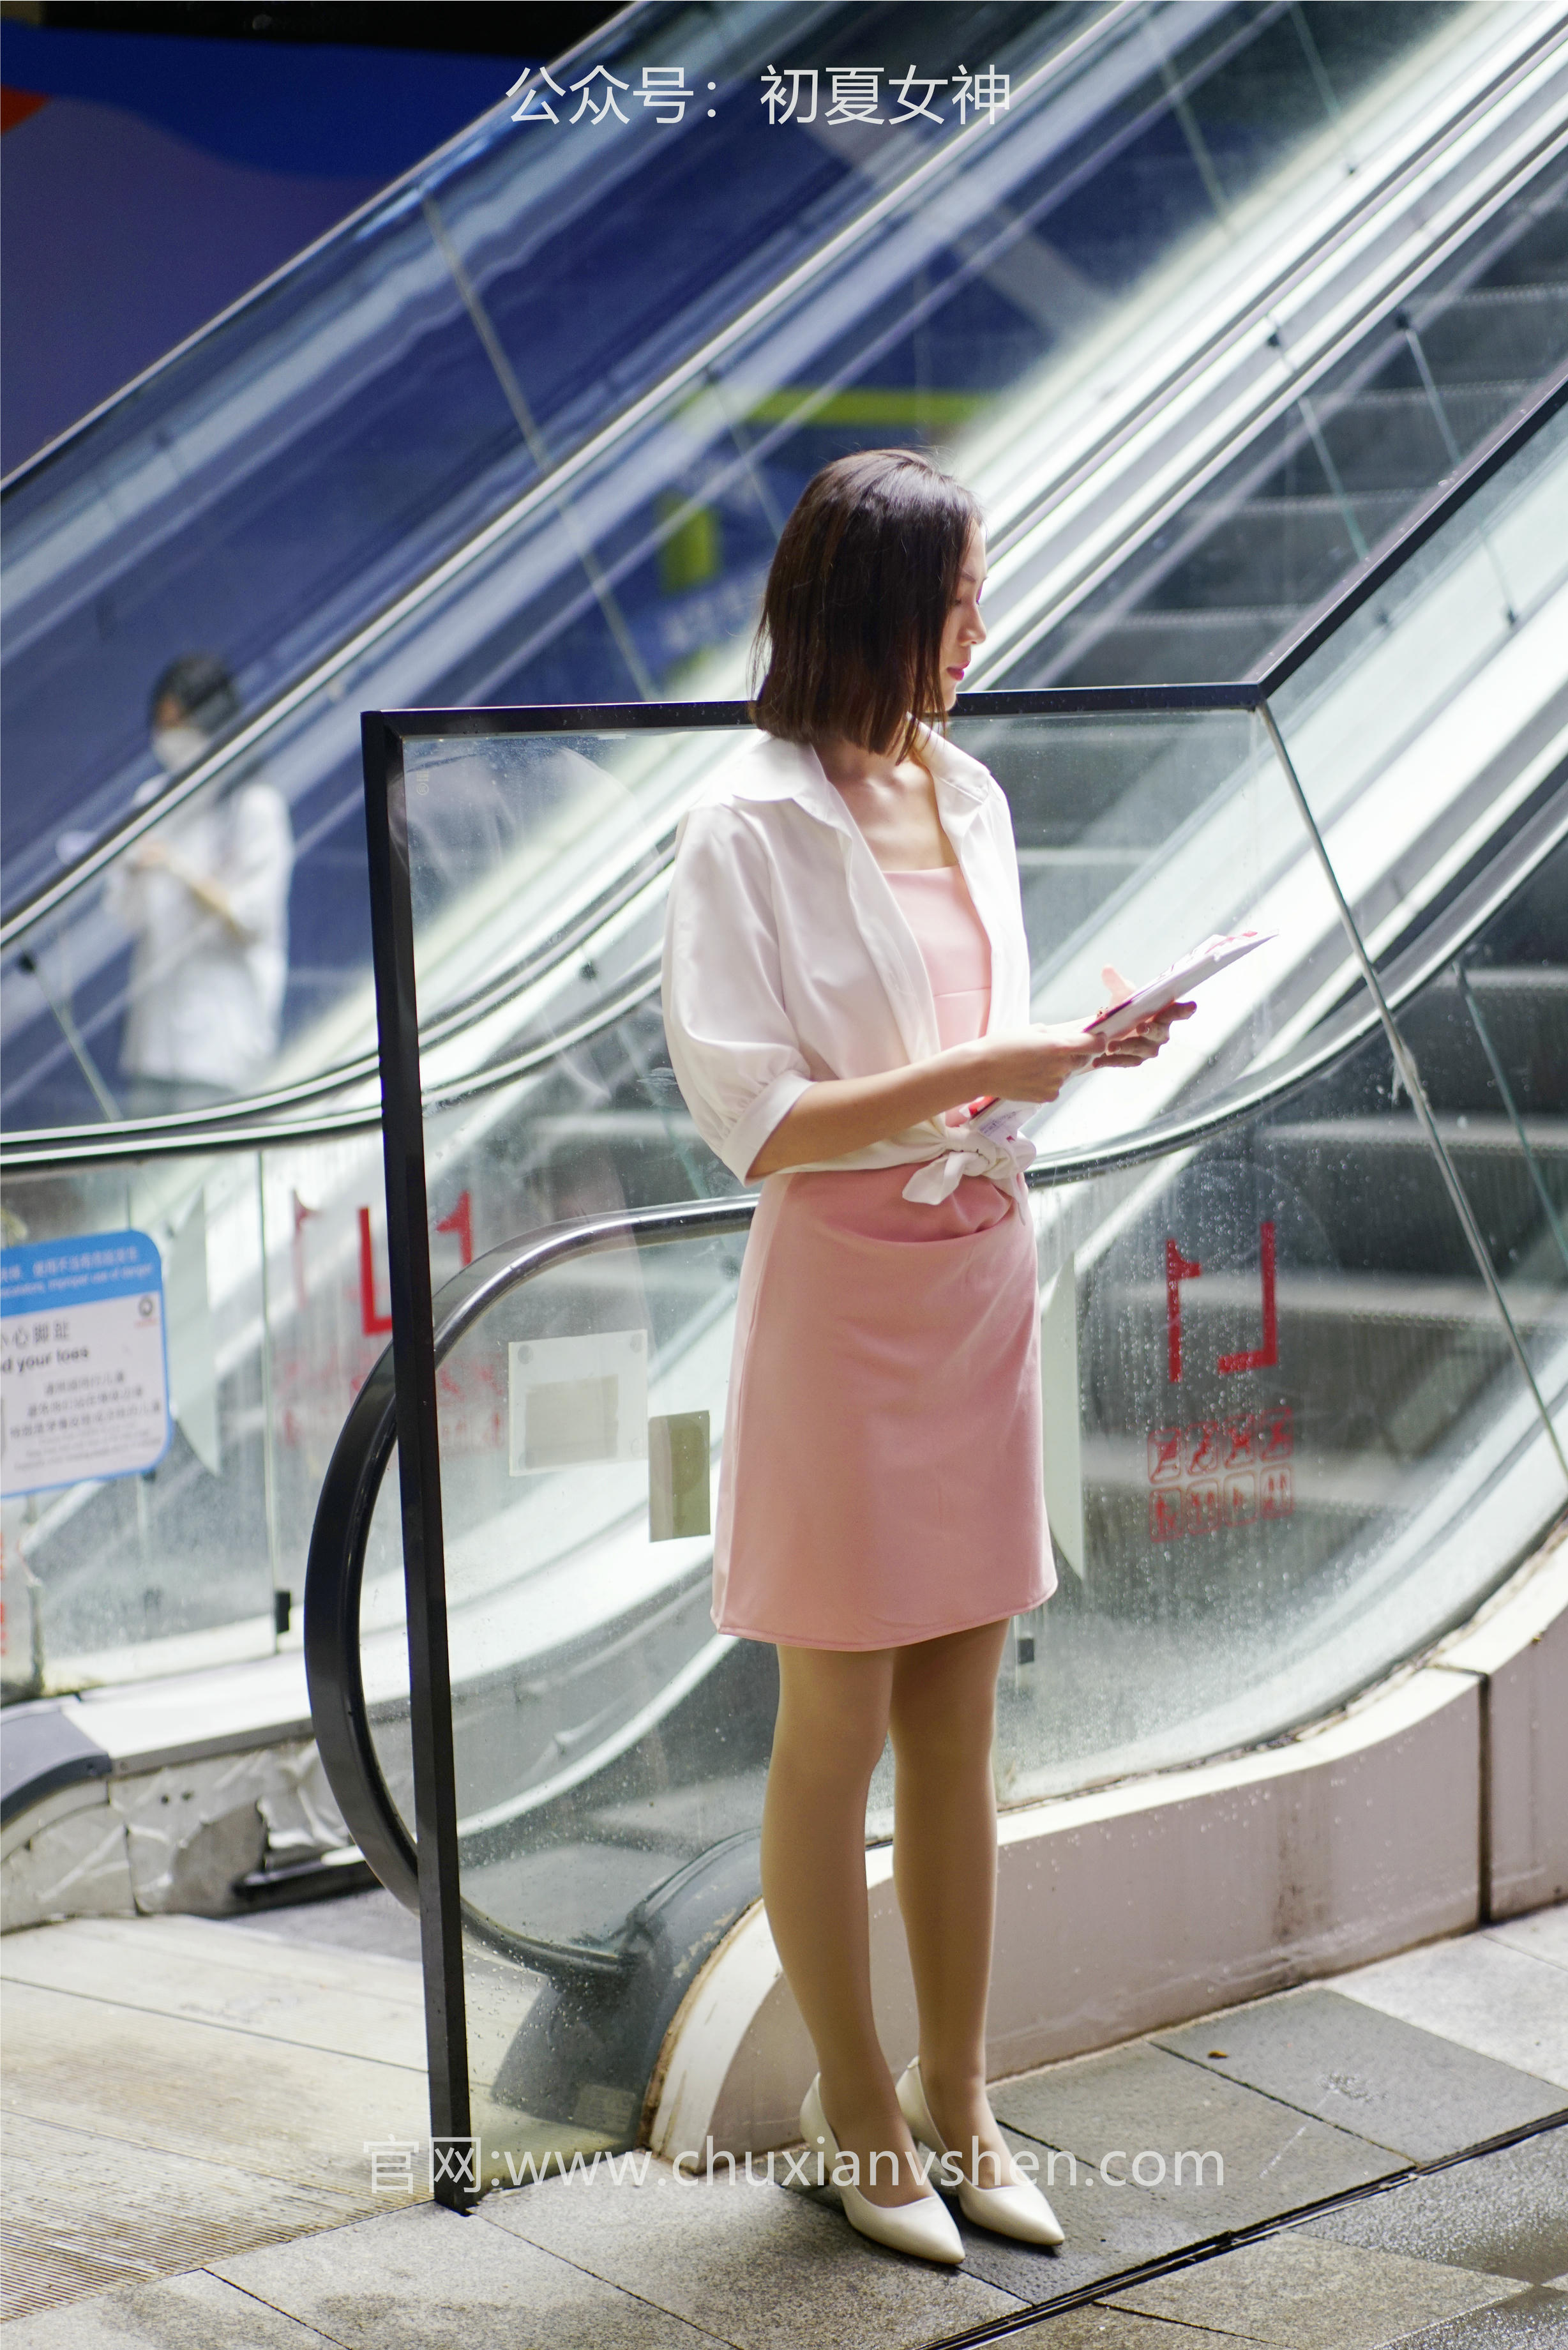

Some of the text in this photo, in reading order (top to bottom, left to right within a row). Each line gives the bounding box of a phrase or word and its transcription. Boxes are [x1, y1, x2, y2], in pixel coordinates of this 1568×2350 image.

[1, 1320, 69, 1349] 心脚趾
[17, 1353, 51, 1374] your
